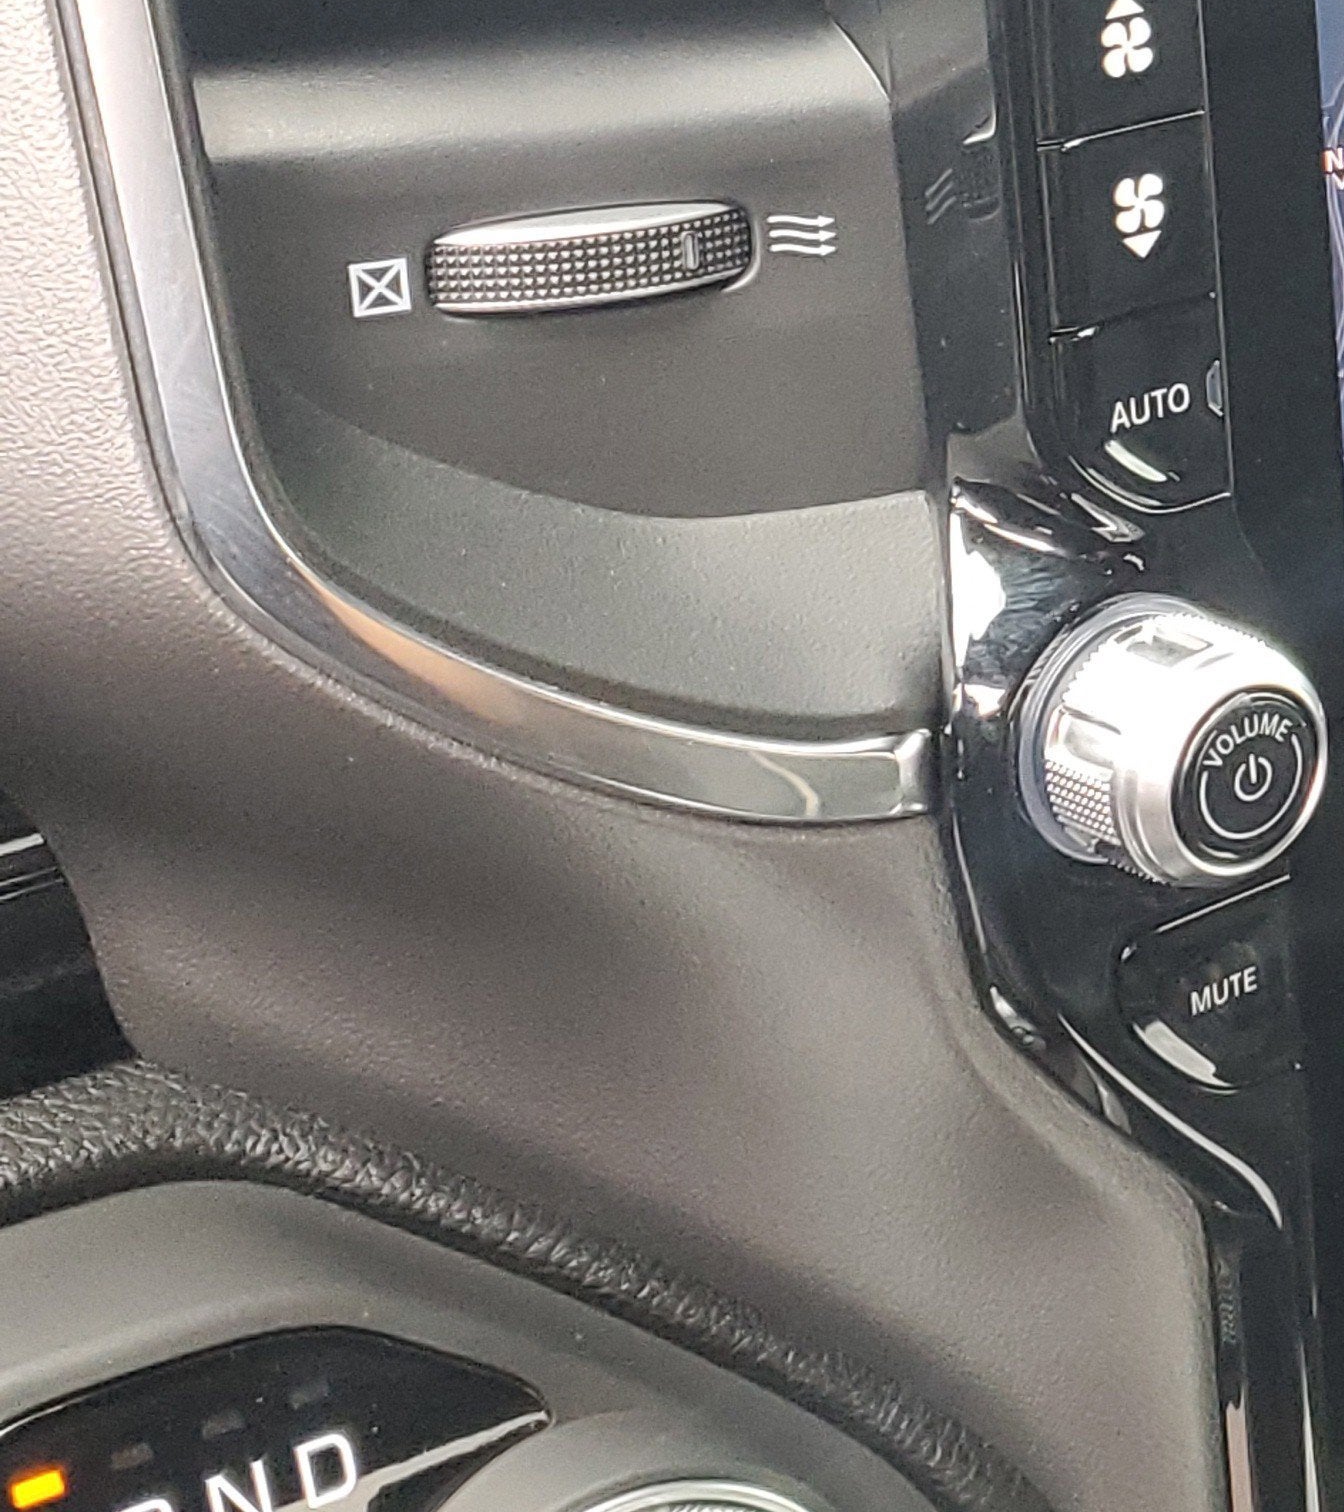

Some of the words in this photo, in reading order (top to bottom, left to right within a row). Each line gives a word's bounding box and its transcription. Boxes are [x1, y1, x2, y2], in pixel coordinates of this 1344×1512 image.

[1109, 382, 1191, 434] AUTO
[1202, 711, 1293, 768] VOLUME
[1190, 965, 1258, 1017] MUTE
[294, 1434, 358, 1510] D
